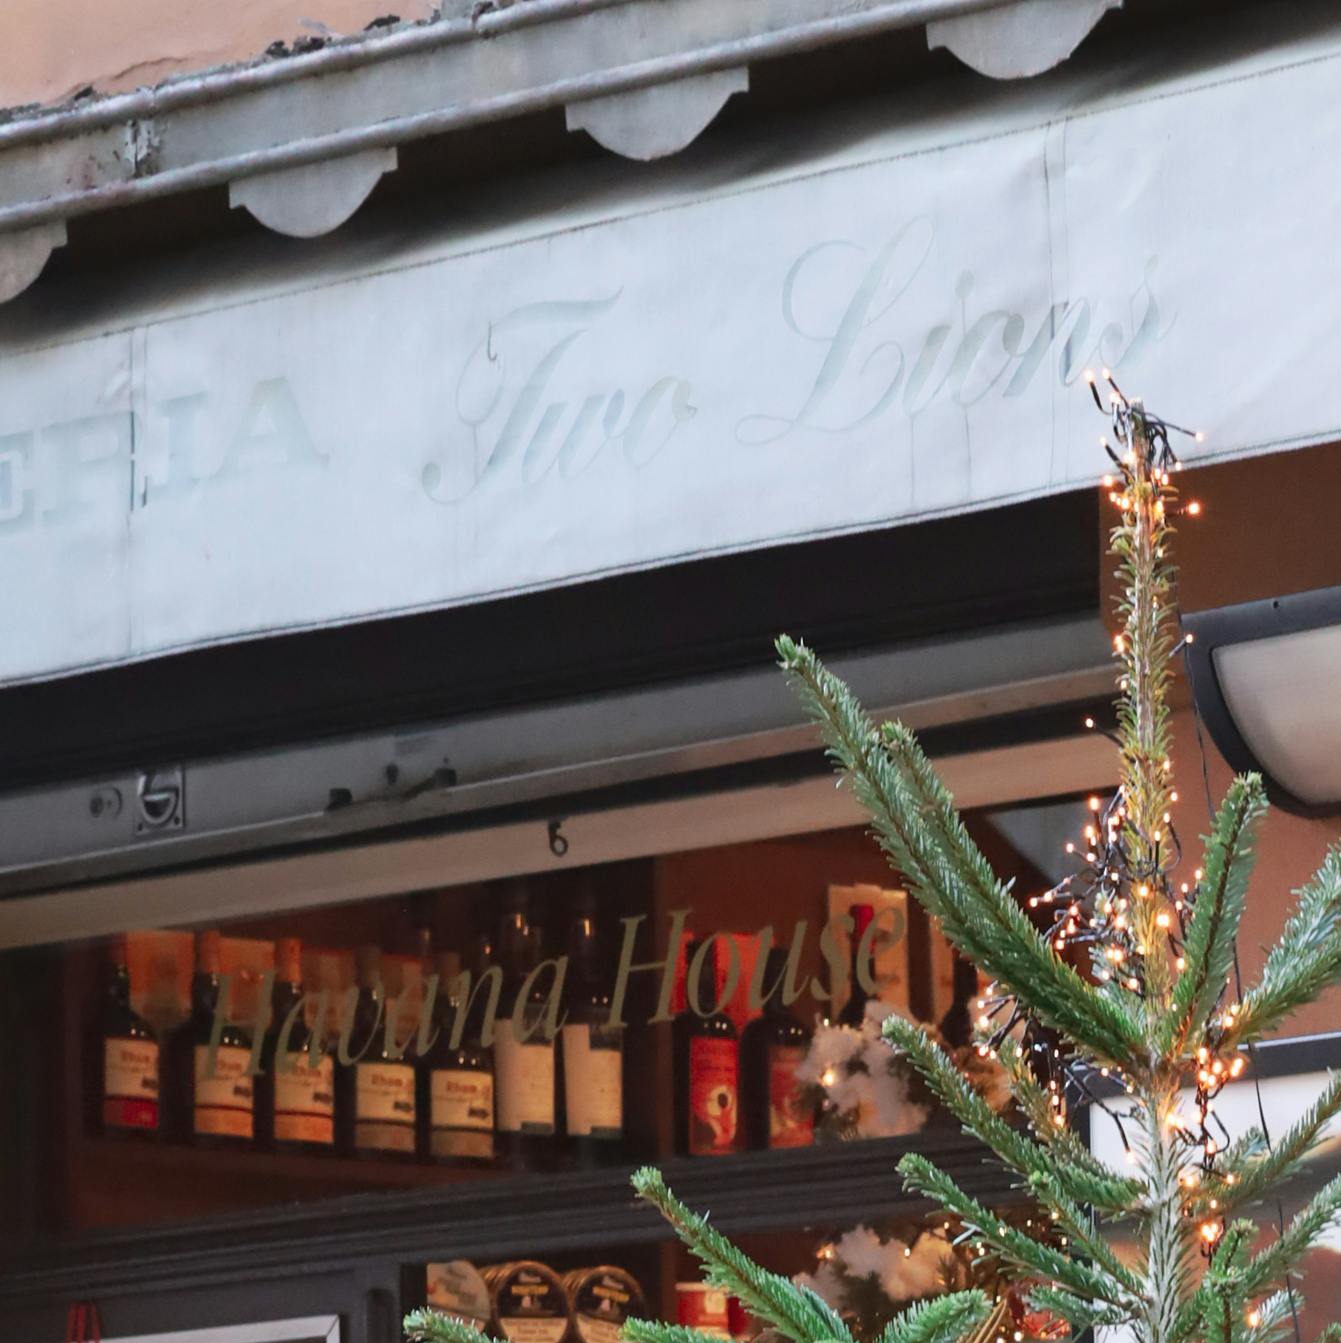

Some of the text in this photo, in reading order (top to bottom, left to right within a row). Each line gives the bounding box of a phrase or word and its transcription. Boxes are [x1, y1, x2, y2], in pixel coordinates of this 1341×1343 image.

[421, 284, 698, 504] Two
[734, 215, 1177, 446] Lions
[206, 905, 905, 1078] Havana House
